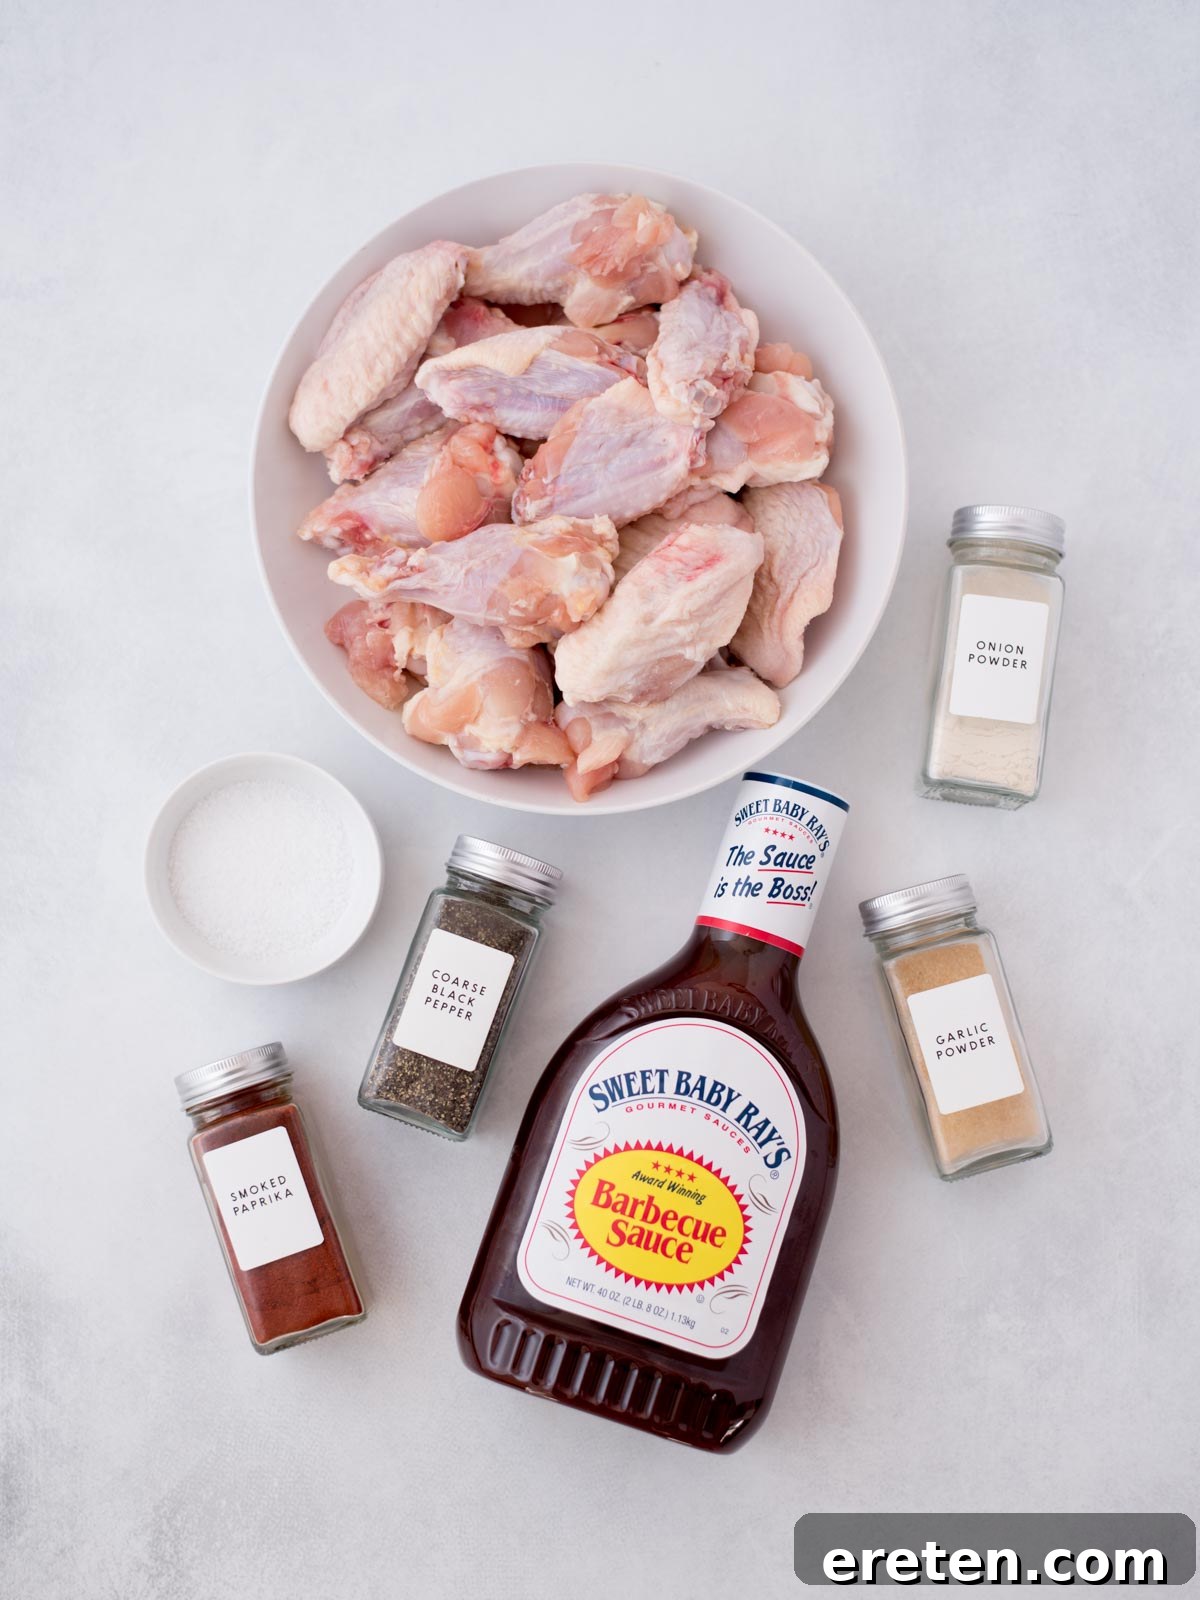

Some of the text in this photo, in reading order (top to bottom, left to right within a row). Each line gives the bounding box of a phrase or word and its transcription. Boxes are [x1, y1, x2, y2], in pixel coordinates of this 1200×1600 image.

[968, 654, 1027, 669] POWDER
[976, 641, 1024, 655] ONION
[734, 798, 830, 852] SWEET BABY RAY'S
[748, 816, 813, 844] GOURMET SAUCES
[726, 844, 816, 870] The Sauce
[714, 875, 818, 902] is the Boss!
[432, 970, 486, 996] COARSE
[432, 984, 475, 1007] BLACK
[424, 997, 472, 1021] PEPPER
[936, 1023, 988, 1045] GARLIC
[936, 1036, 995, 1060] POWDER
[588, 1069, 792, 1169] SWEET BABY RAY'S
[626, 1102, 751, 1154] GOURMET SAUCES
[231, 1176, 286, 1201] SMOKED
[632, 1170, 707, 1205] Award Winning
[233, 1189, 293, 1216] PAPRIKA
[590, 1178, 727, 1248] Barbecue
[606, 1218, 694, 1264] Sauce
[566, 1276, 696, 1330] NET WT. 40 OZ. (2 LB. 8 OZ.) 1.13kg
